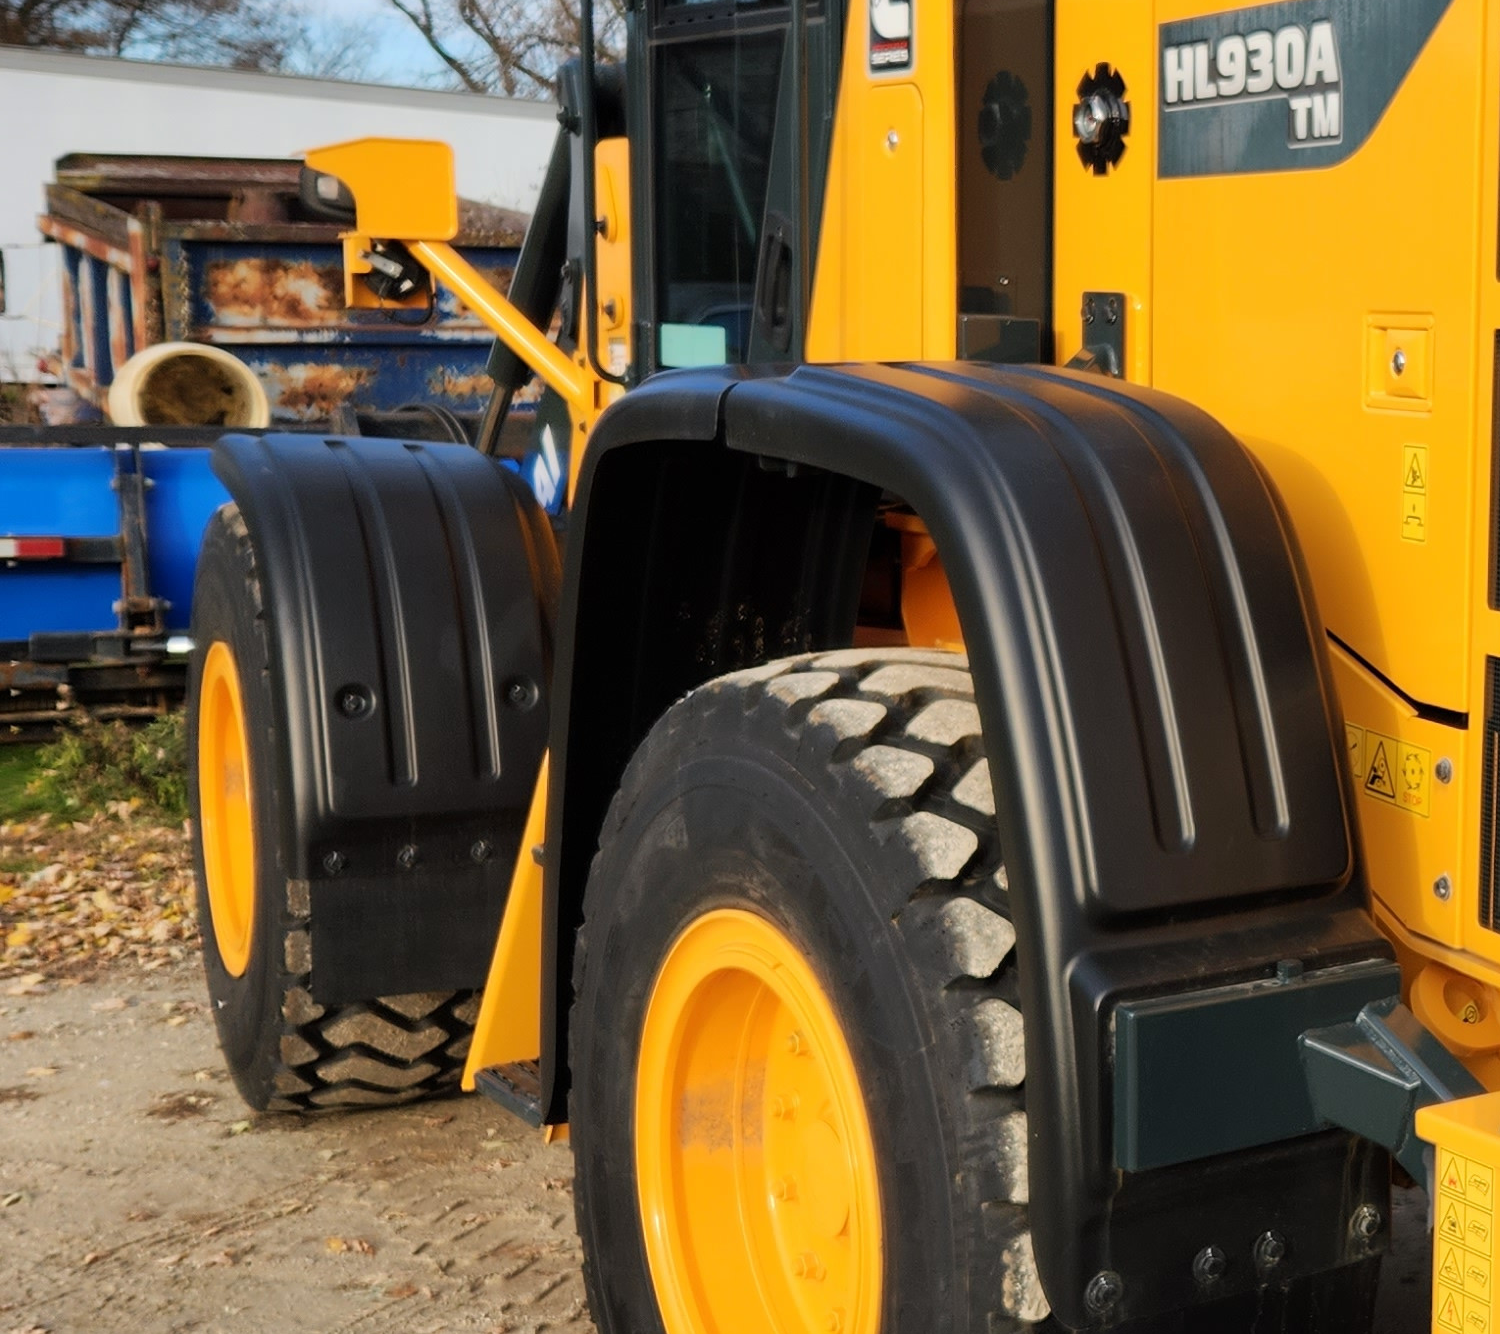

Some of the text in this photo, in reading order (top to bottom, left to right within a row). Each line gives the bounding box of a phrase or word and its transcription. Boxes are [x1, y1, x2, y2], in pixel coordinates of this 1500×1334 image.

[1164, 21, 1339, 104] HL930A
[1288, 91, 1340, 140] TM
[1403, 791, 1421, 805] STOP
